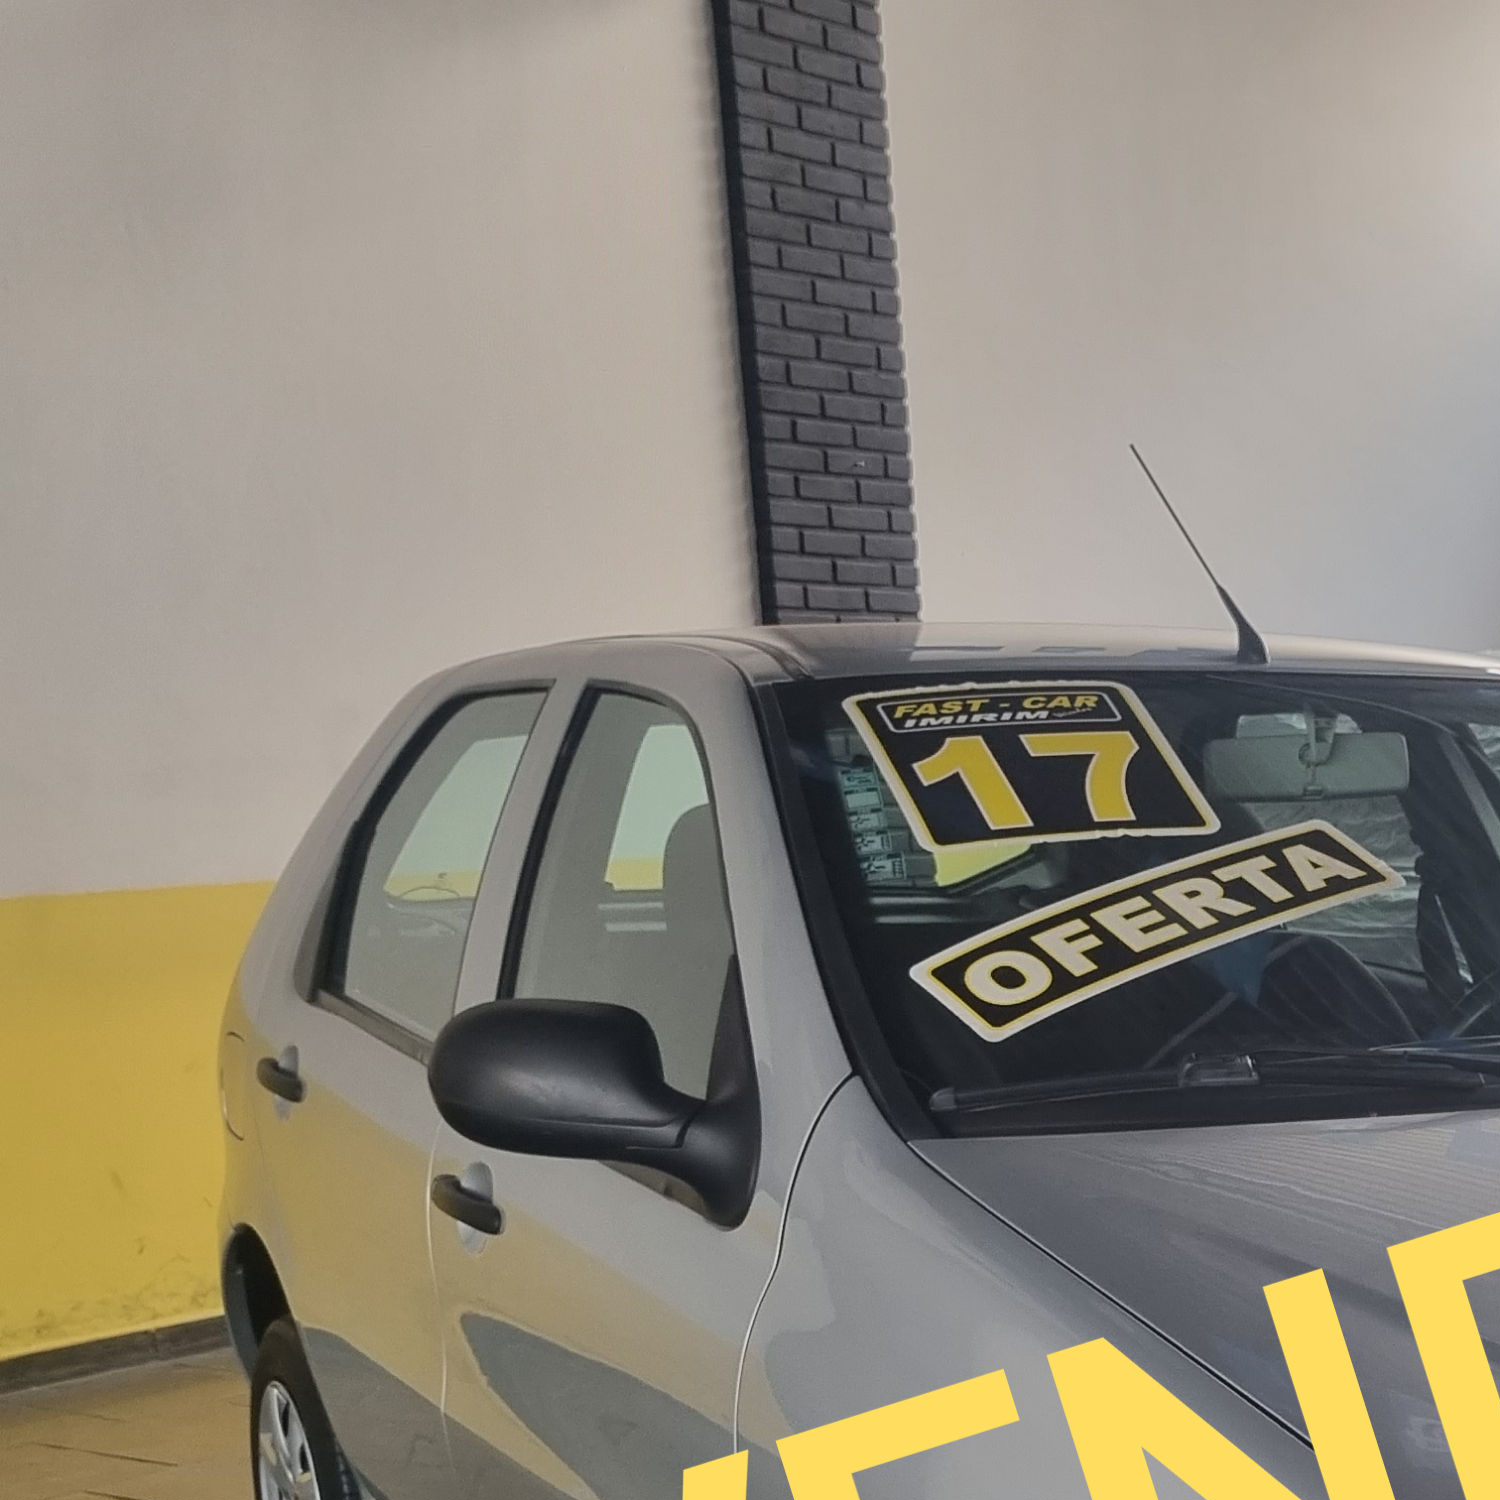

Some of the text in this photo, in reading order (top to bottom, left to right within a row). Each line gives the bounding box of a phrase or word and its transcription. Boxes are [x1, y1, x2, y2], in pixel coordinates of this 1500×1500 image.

[893, 698, 990, 718] FAST
[1022, 695, 1099, 709] CAR
[903, 710, 1051, 728] IMIRIM
[911, 730, 1140, 831] 17
[963, 843, 1368, 1006] OFERTA
